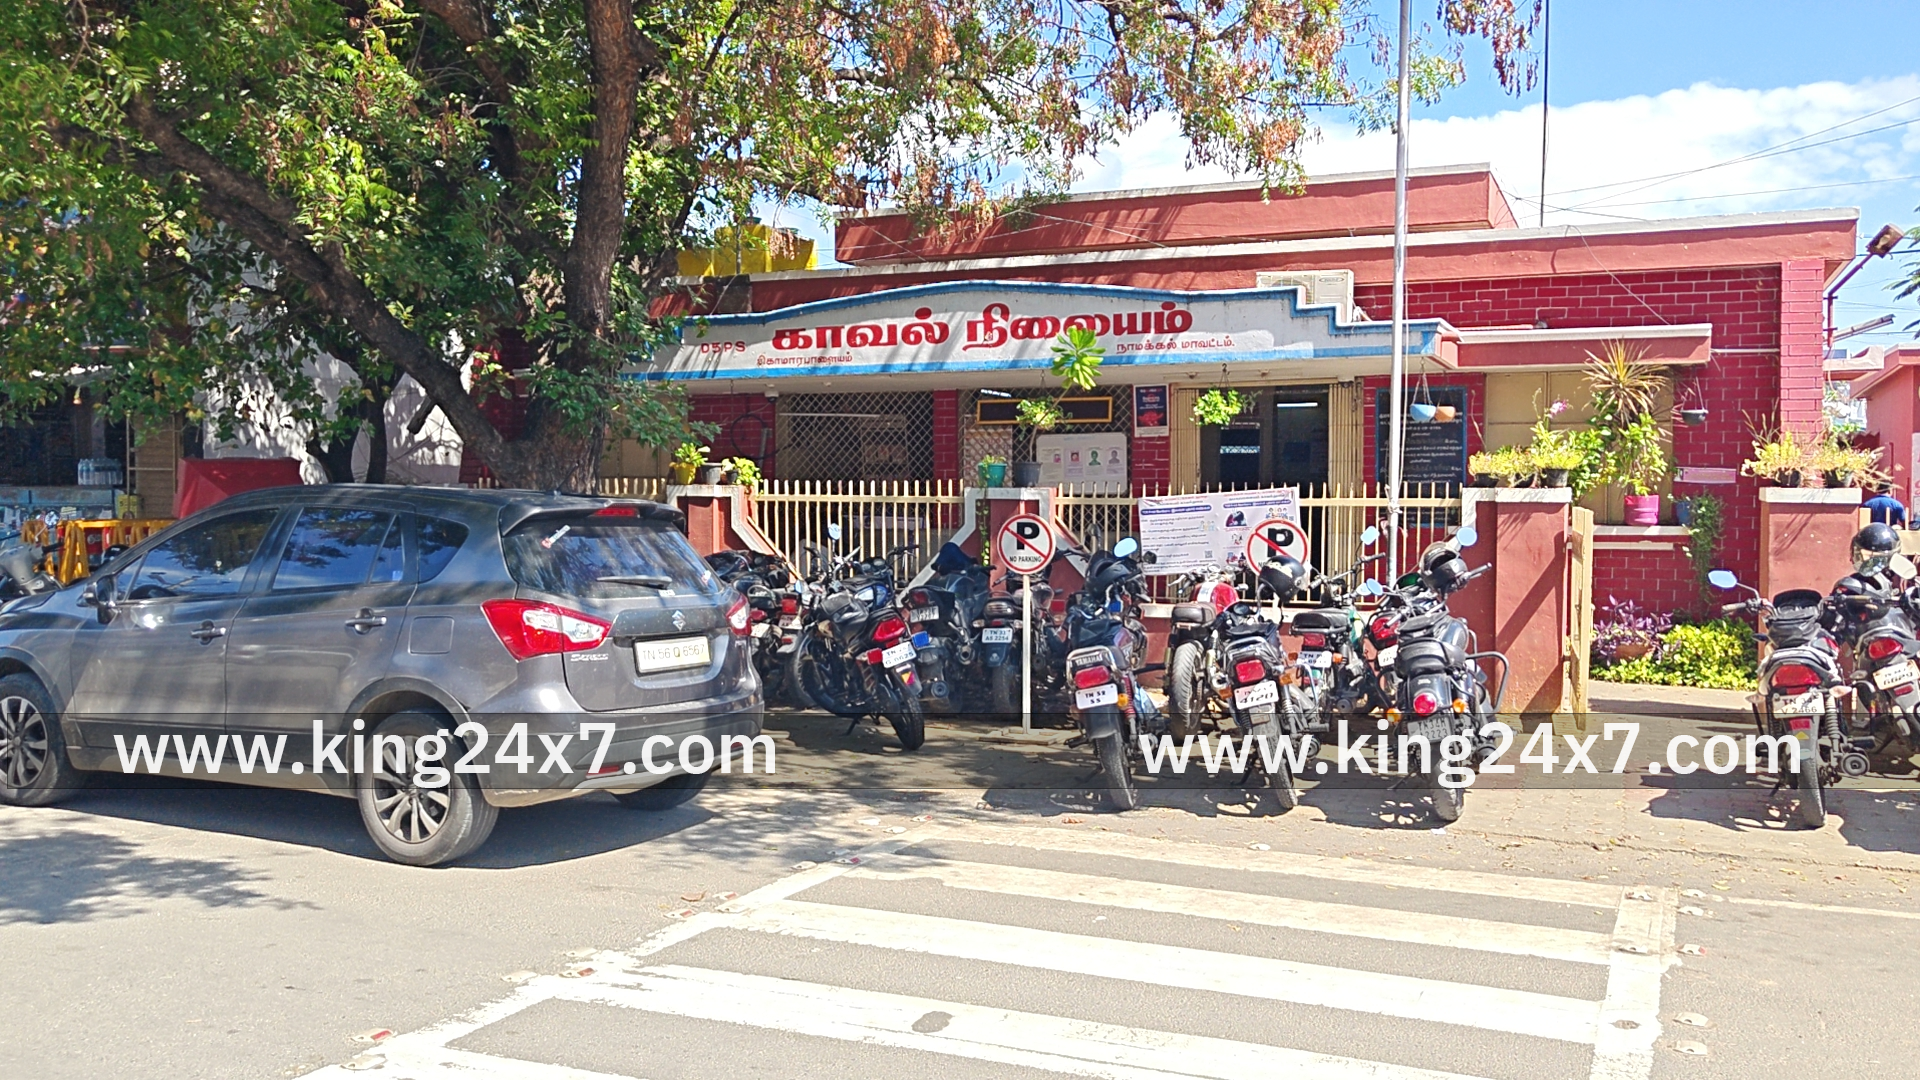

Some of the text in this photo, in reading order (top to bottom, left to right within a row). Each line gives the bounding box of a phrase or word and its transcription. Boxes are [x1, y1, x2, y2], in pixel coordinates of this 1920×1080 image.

[772, 301, 1193, 351] காவல் நிலையம்
[1116, 337, 1177, 354] நாமக்கல்
[1017, 522, 1040, 550] P
[1267, 528, 1294, 557] P
[1019, 555, 1042, 563] PARKING
[642, 649, 656, 661] TN
[658, 647, 670, 660] 56
